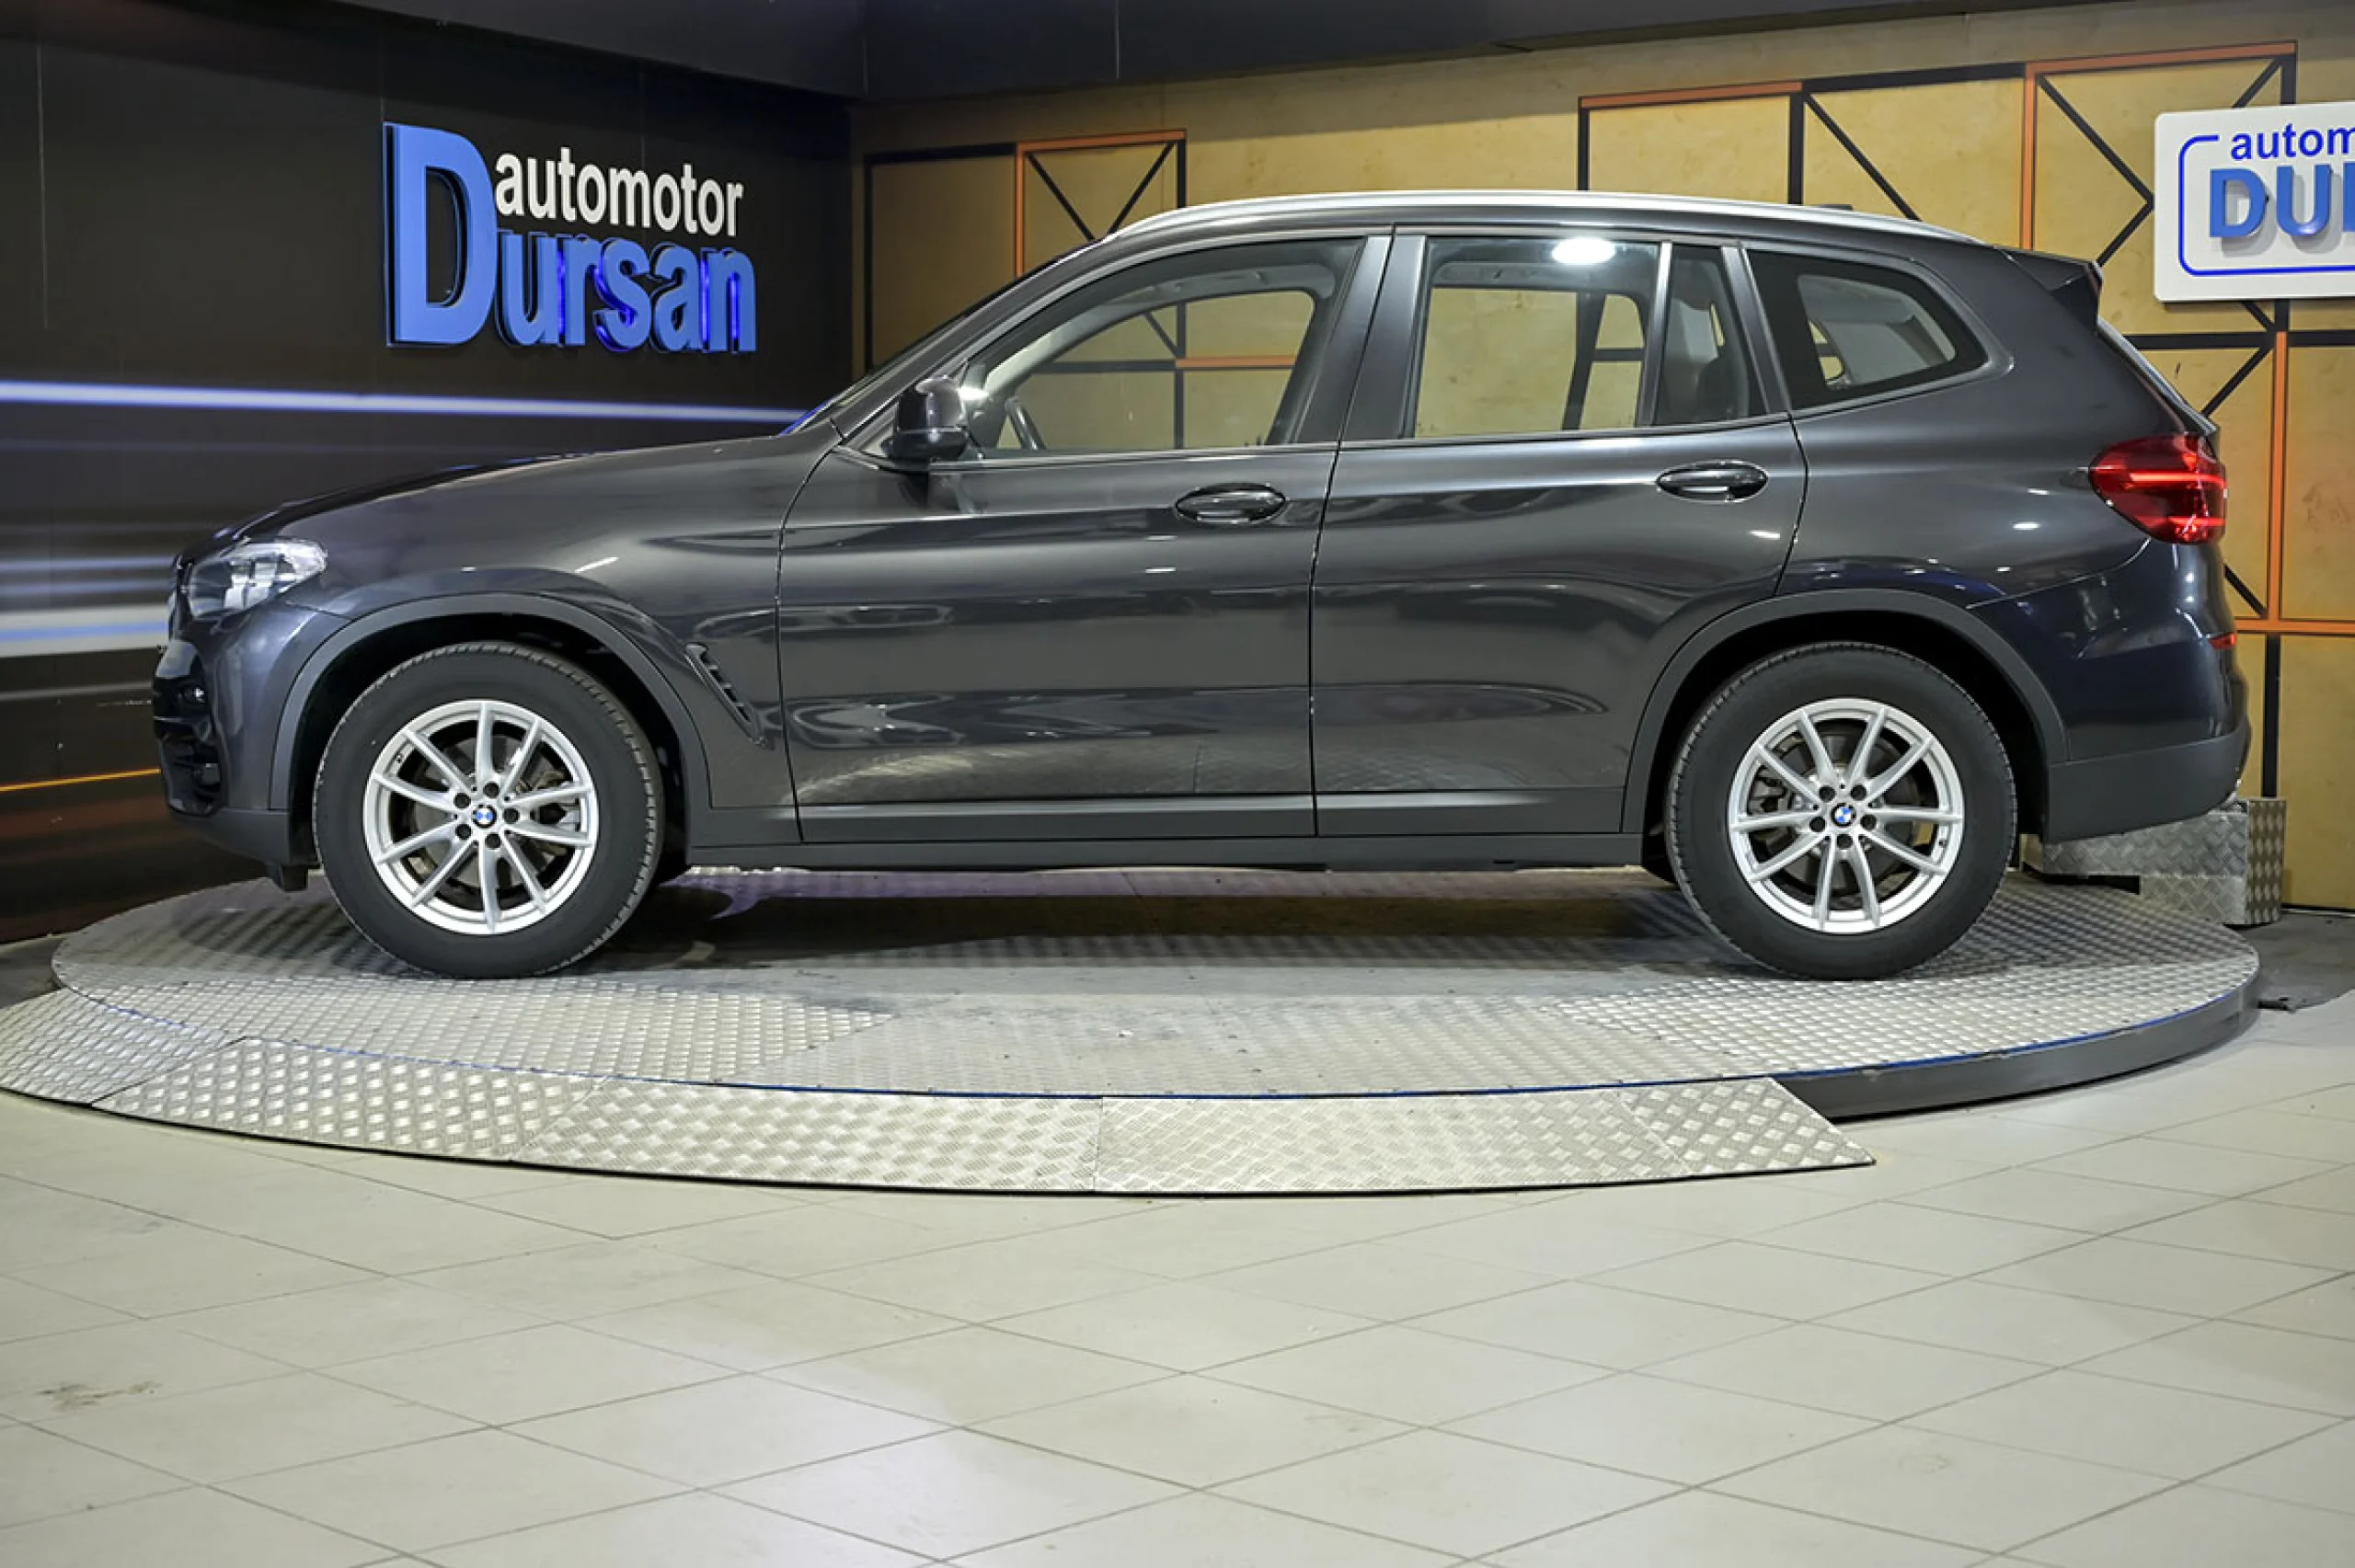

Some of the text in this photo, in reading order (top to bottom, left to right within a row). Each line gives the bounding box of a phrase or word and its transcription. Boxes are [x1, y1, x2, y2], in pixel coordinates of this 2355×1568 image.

[495, 147, 744, 236] automotor
[2210, 162, 2355, 238] DU
[383, 121, 757, 353] Dursan
